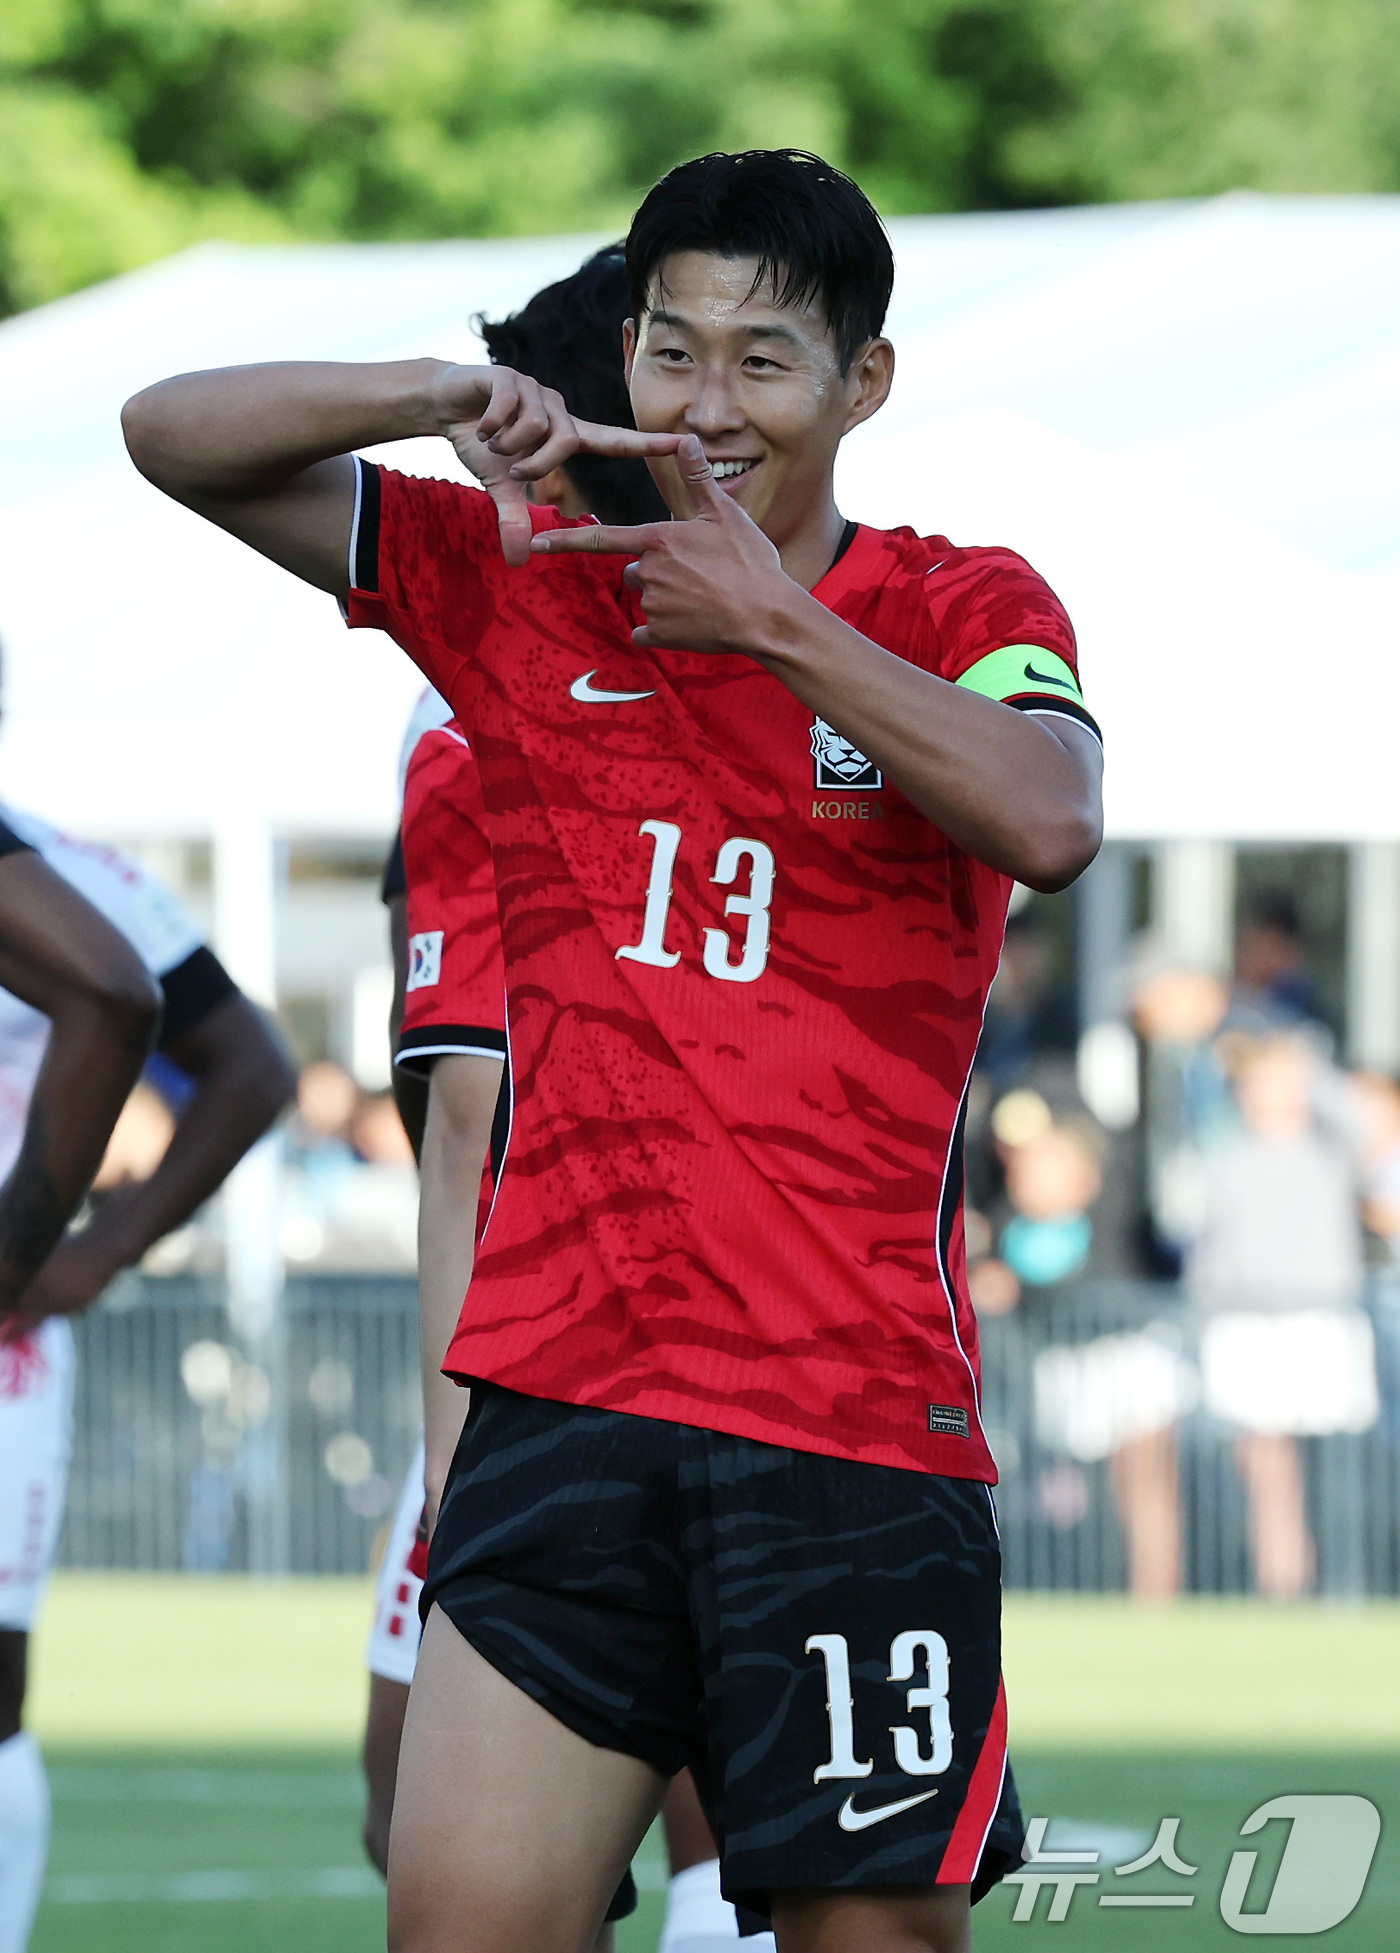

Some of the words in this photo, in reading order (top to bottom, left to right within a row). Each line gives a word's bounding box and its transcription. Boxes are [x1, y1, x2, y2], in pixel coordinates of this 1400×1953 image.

[811, 801, 884, 819] KOREA
[615, 818, 777, 983] 13
[804, 1629, 955, 1785] 13
